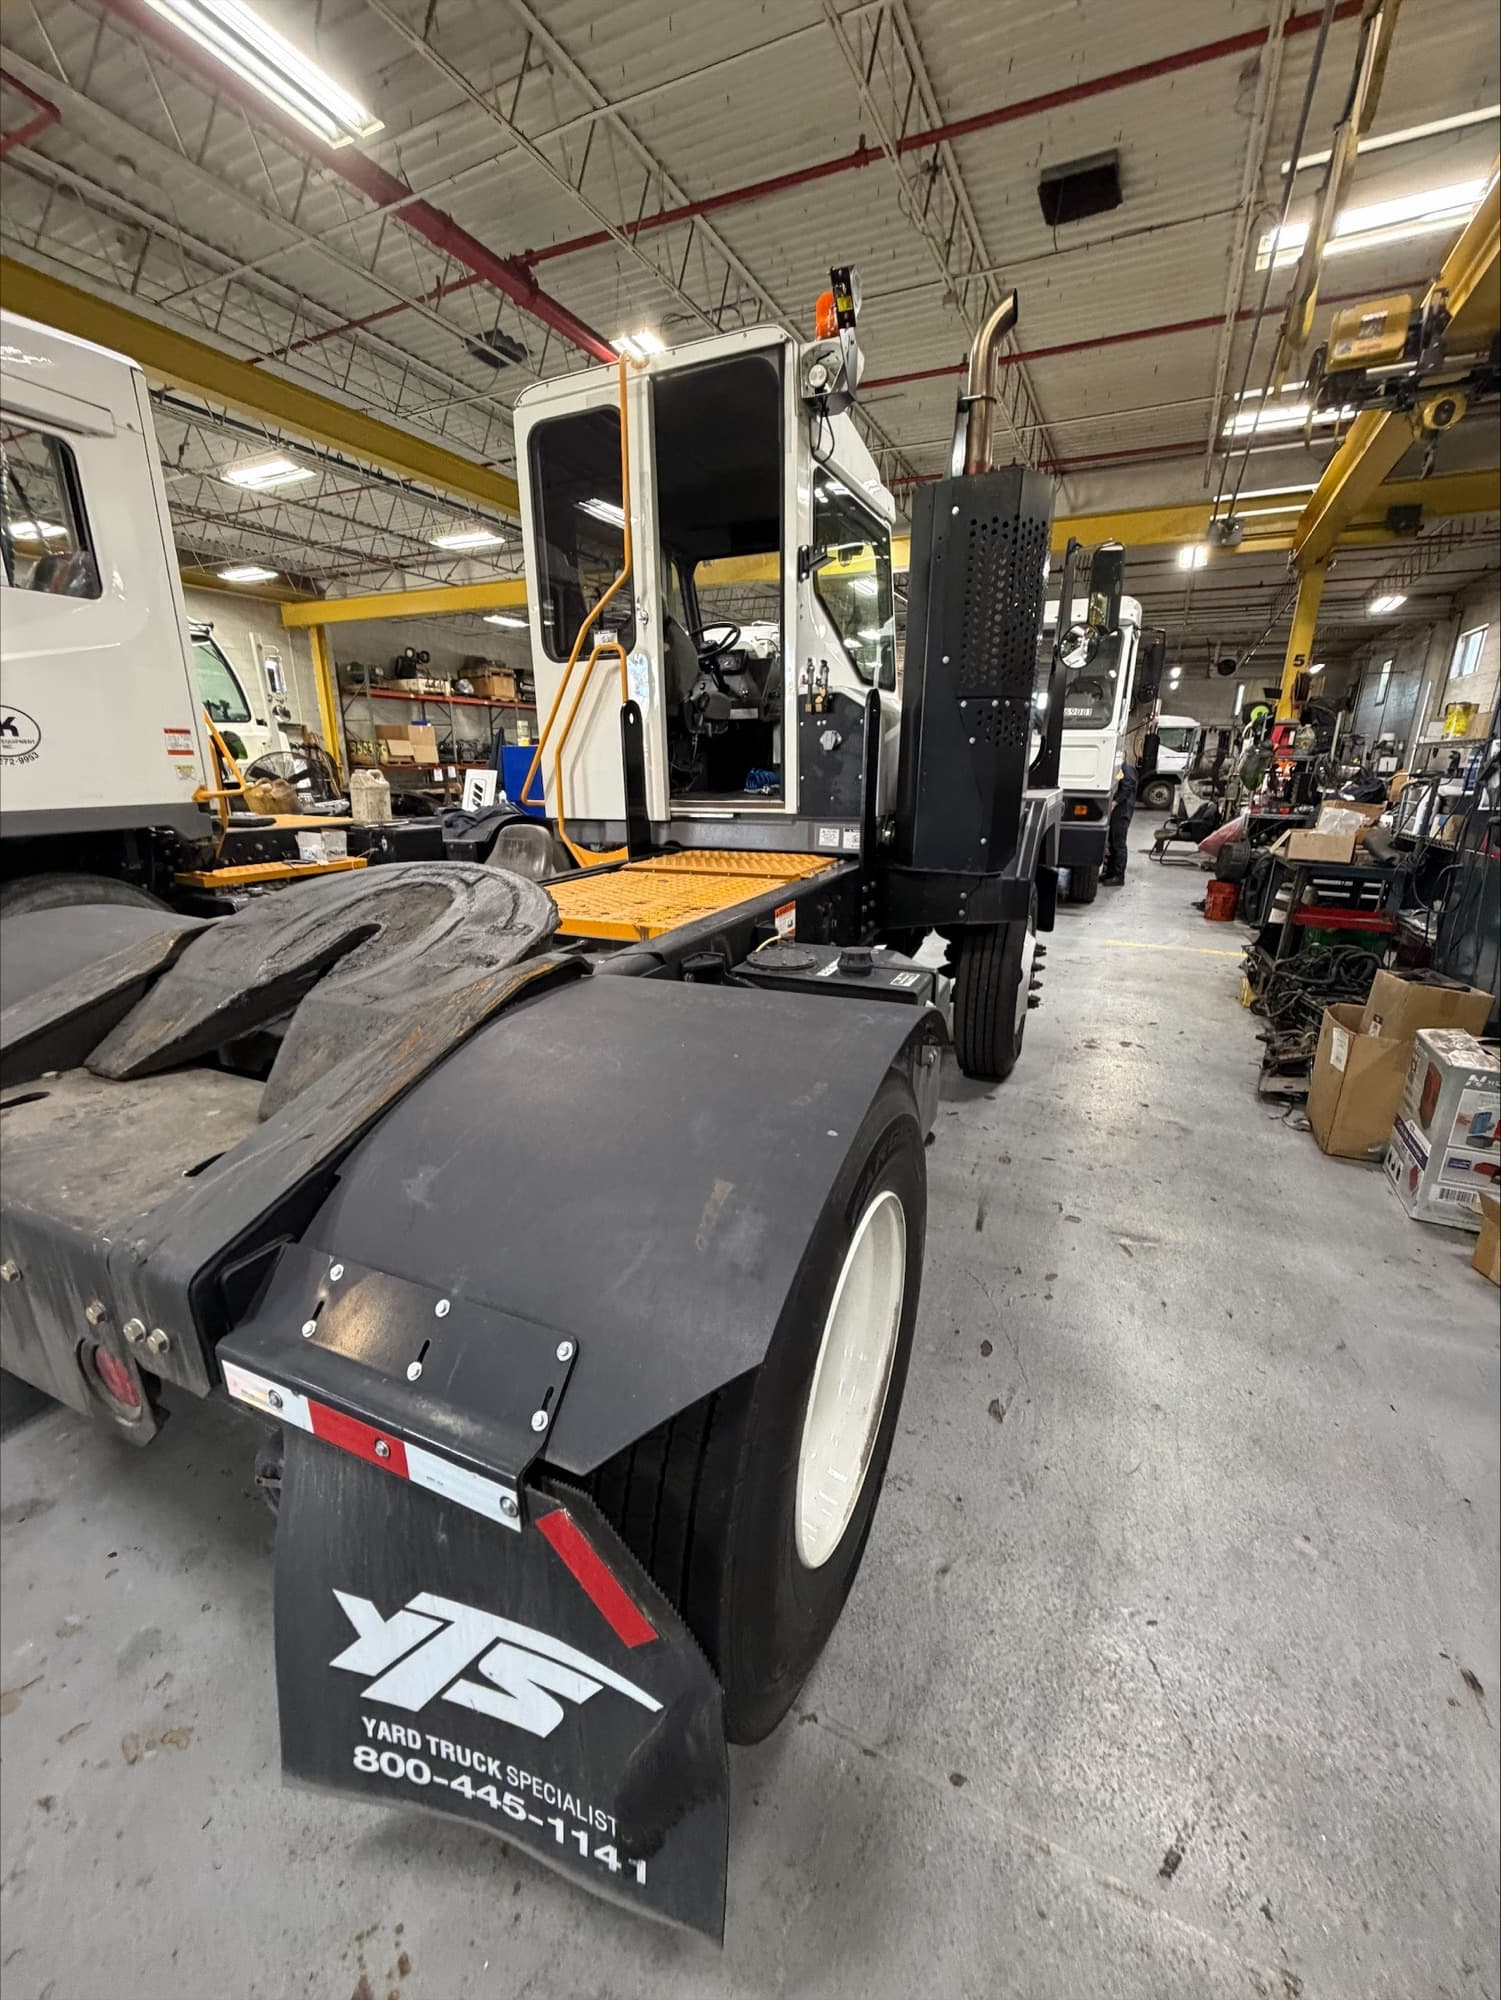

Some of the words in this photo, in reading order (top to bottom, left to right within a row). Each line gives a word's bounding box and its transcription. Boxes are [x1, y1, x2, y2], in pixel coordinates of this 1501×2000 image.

[1293, 654, 1305, 667] 5
[0, 751, 40, 766] 72-9953
[329, 1588, 664, 1738] YTS
[353, 1745, 647, 1886] 800-445-1141
[361, 1715, 422, 1750] YARD
[425, 1734, 503, 1780] TRUCK
[506, 1765, 632, 1844] SPECIALIST
